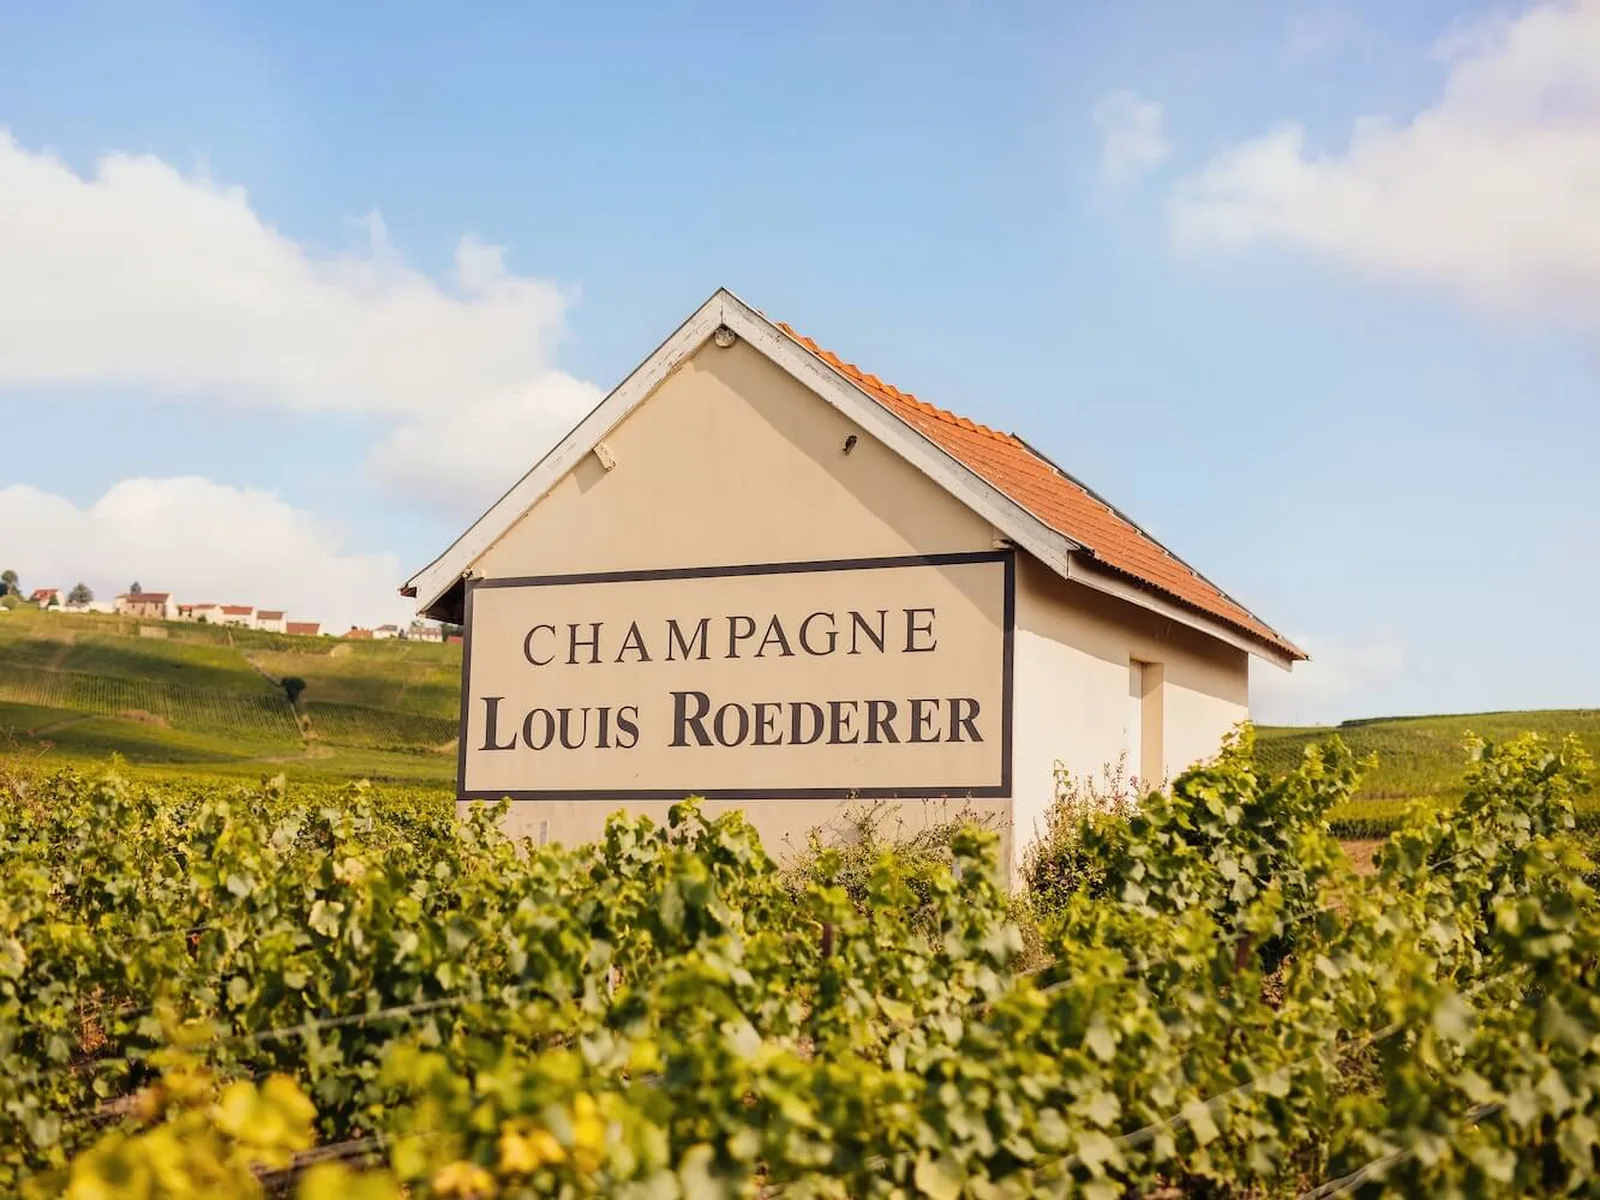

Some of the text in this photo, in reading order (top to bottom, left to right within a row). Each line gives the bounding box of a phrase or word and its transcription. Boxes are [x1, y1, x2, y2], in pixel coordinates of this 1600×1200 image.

[523, 607, 938, 666] CHAMPAGNE
[478, 691, 984, 751] LOUIS ROEDERER
